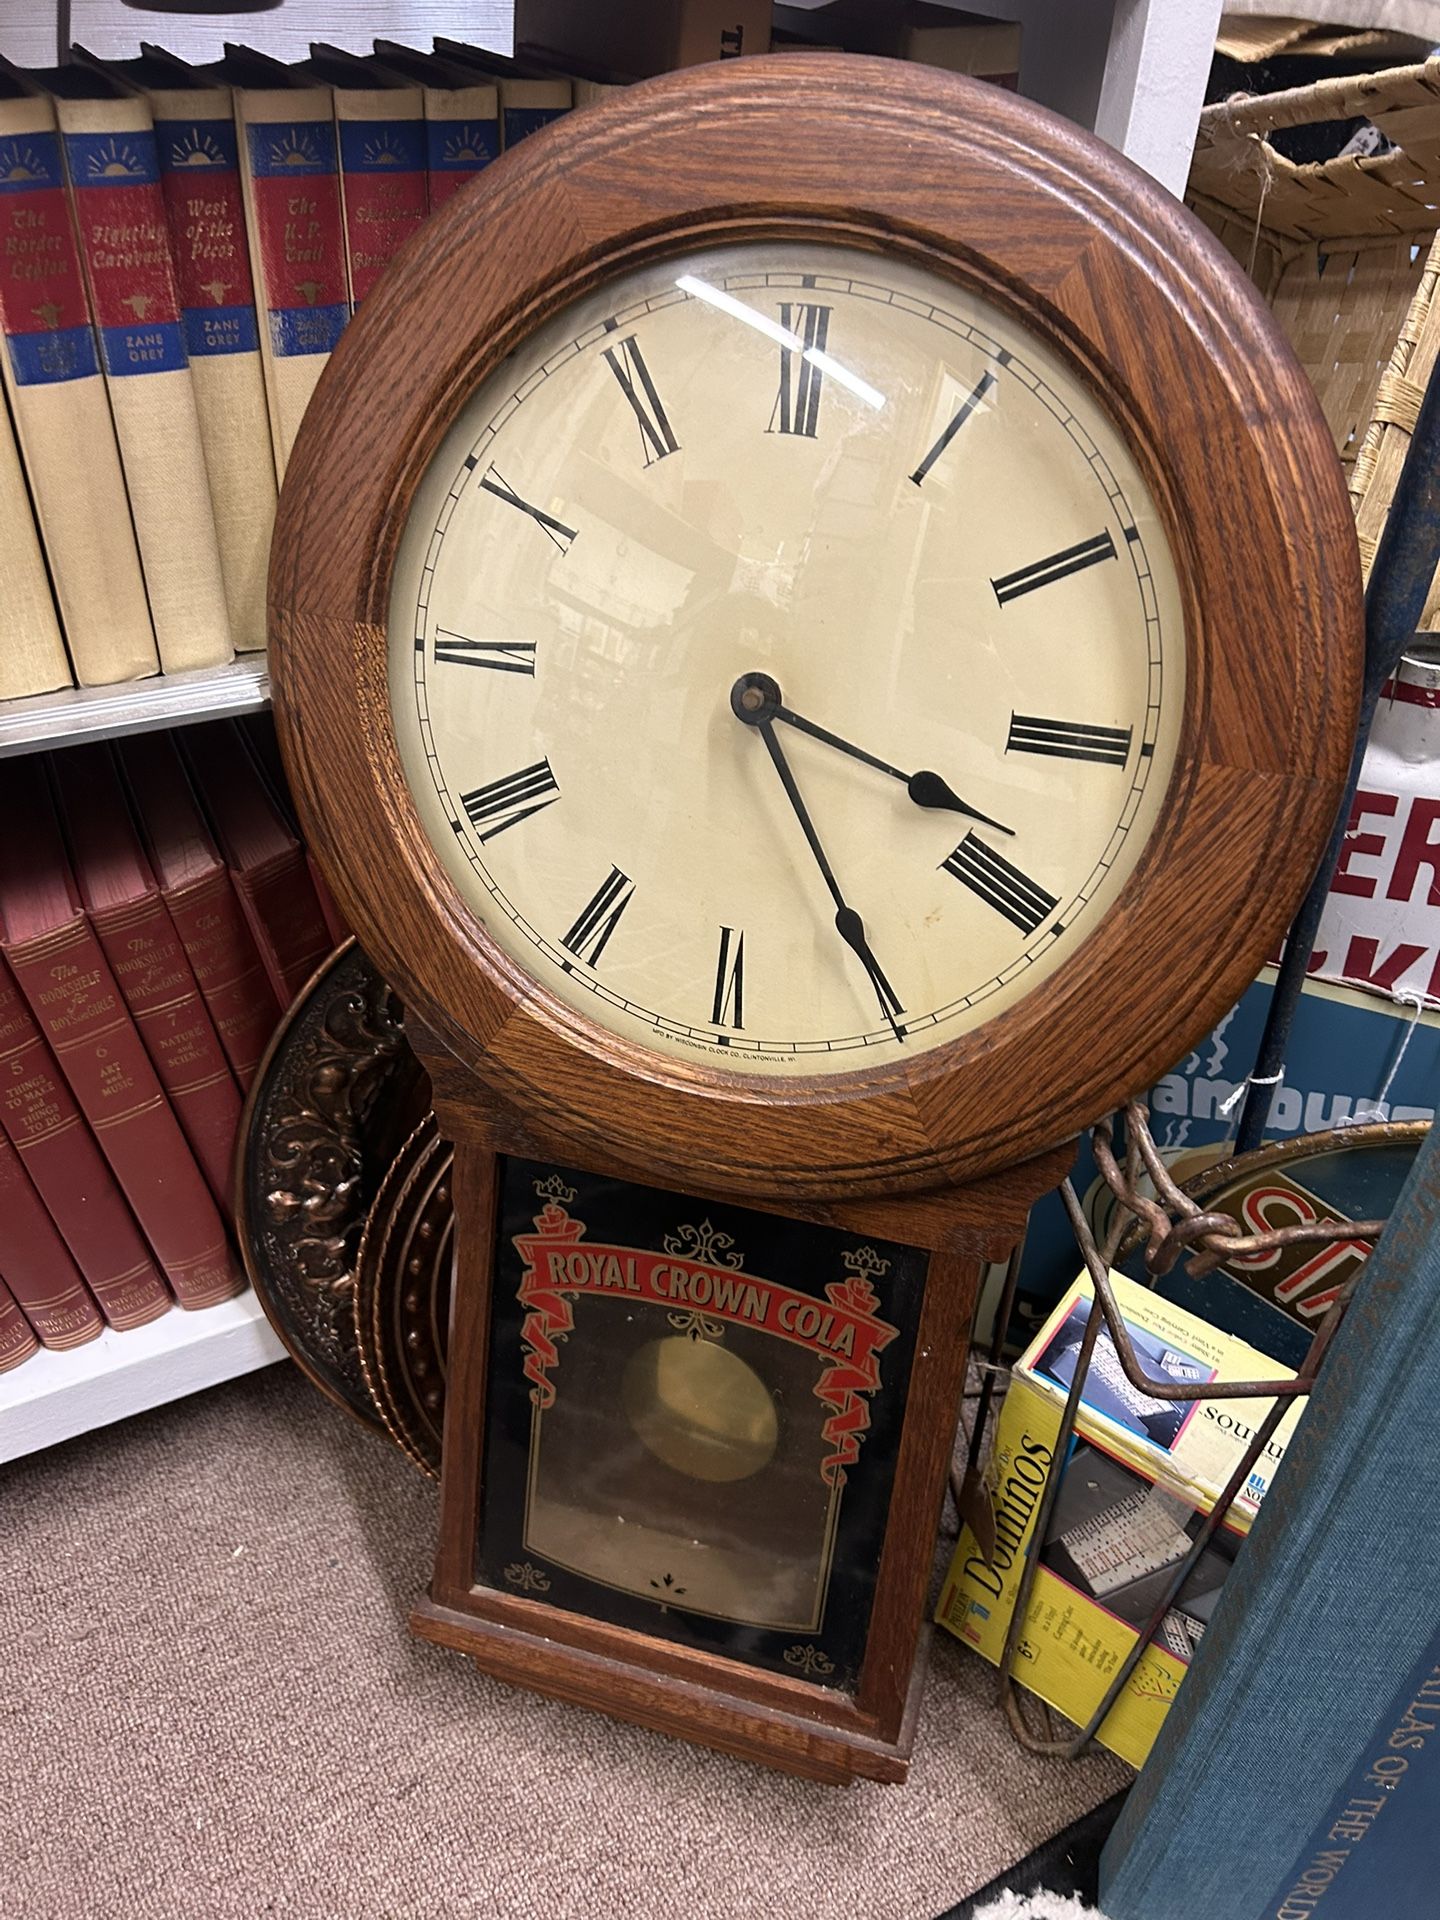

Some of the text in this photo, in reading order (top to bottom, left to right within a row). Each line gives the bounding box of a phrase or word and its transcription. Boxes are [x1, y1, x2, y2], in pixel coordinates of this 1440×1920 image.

[187, 198, 228, 216] West
[288, 198, 316, 216] The
[92, 224, 167, 247] Fighting
[186, 220, 233, 241] of the
[6, 236, 62, 256] Border
[191, 244, 236, 261] Pecos
[12, 260, 67, 280] Legion
[204, 320, 240, 332] ZANE
[126, 334, 163, 348] ZANE
[207, 332, 240, 346] GREY
[129, 348, 164, 362] GREY
[764, 302, 833, 439] XII
[600, 333, 682, 469] XI
[908, 369, 998, 487] I
[479, 460, 580, 557] X
[990, 527, 1118, 609] II
[434, 624, 538, 678] IX
[1004, 709, 1133, 771] III
[458, 755, 562, 846] VIII
[936, 827, 1062, 940] IIII
[558, 863, 637, 971] VII
[128, 938, 154, 955] The
[115, 943, 176, 975] BOOKSHELF
[51, 964, 78, 981] The
[708, 925, 745, 1030] VI
[40, 970, 100, 1006] BOOKSHELF
[126, 985, 150, 1001] BOYS
[162, 968, 190, 989] GIRLS
[50, 1014, 78, 1032] BOYS
[88, 995, 116, 1018] GIRLS
[66, 992, 90, 1014] for
[167, 1013, 176, 1027] 7
[160, 1026, 206, 1049] NATURE
[176, 1044, 194, 1054] and
[652, 1028, 665, 1038] MFD
[666, 1033, 674, 1041] BY
[675, 1036, 707, 1051] WISCONSIN
[708, 1046, 729, 1056] CLOCK
[96, 1047, 108, 1058] 6
[10, 1060, 24, 1076] 5
[100, 1062, 120, 1078] ART
[6, 1074, 47, 1098] THINGS
[102, 1078, 134, 1098] MUSIC
[106, 1074, 123, 1086] and
[6, 1081, 56, 1110] TO MAKE
[28, 1098, 46, 1113] and
[21, 1102, 60, 1126] THINGS
[28, 1114, 61, 1134] TO DO
[106, 1278, 160, 1308] UNIVERSITY
[115, 1292, 157, 1313] SOCIETY
[546, 1249, 857, 1360] ROYAL CROWN COLA
[36, 1303, 91, 1328] UNIVERSITY
[1143, 1307, 1160, 1319] Case
[46, 1316, 88, 1334] SOCIETY
[1160, 1314, 1190, 1337] Carrying
[1191, 1333, 1209, 1349] Vinyl
[963, 1433, 1053, 1601] Dominos
[1017, 1640, 1034, 1660] 6+
[1363, 1755, 1409, 1791] OF
[1327, 1795, 1388, 1842] THE
[1276, 1849, 1351, 1920] WORLD
